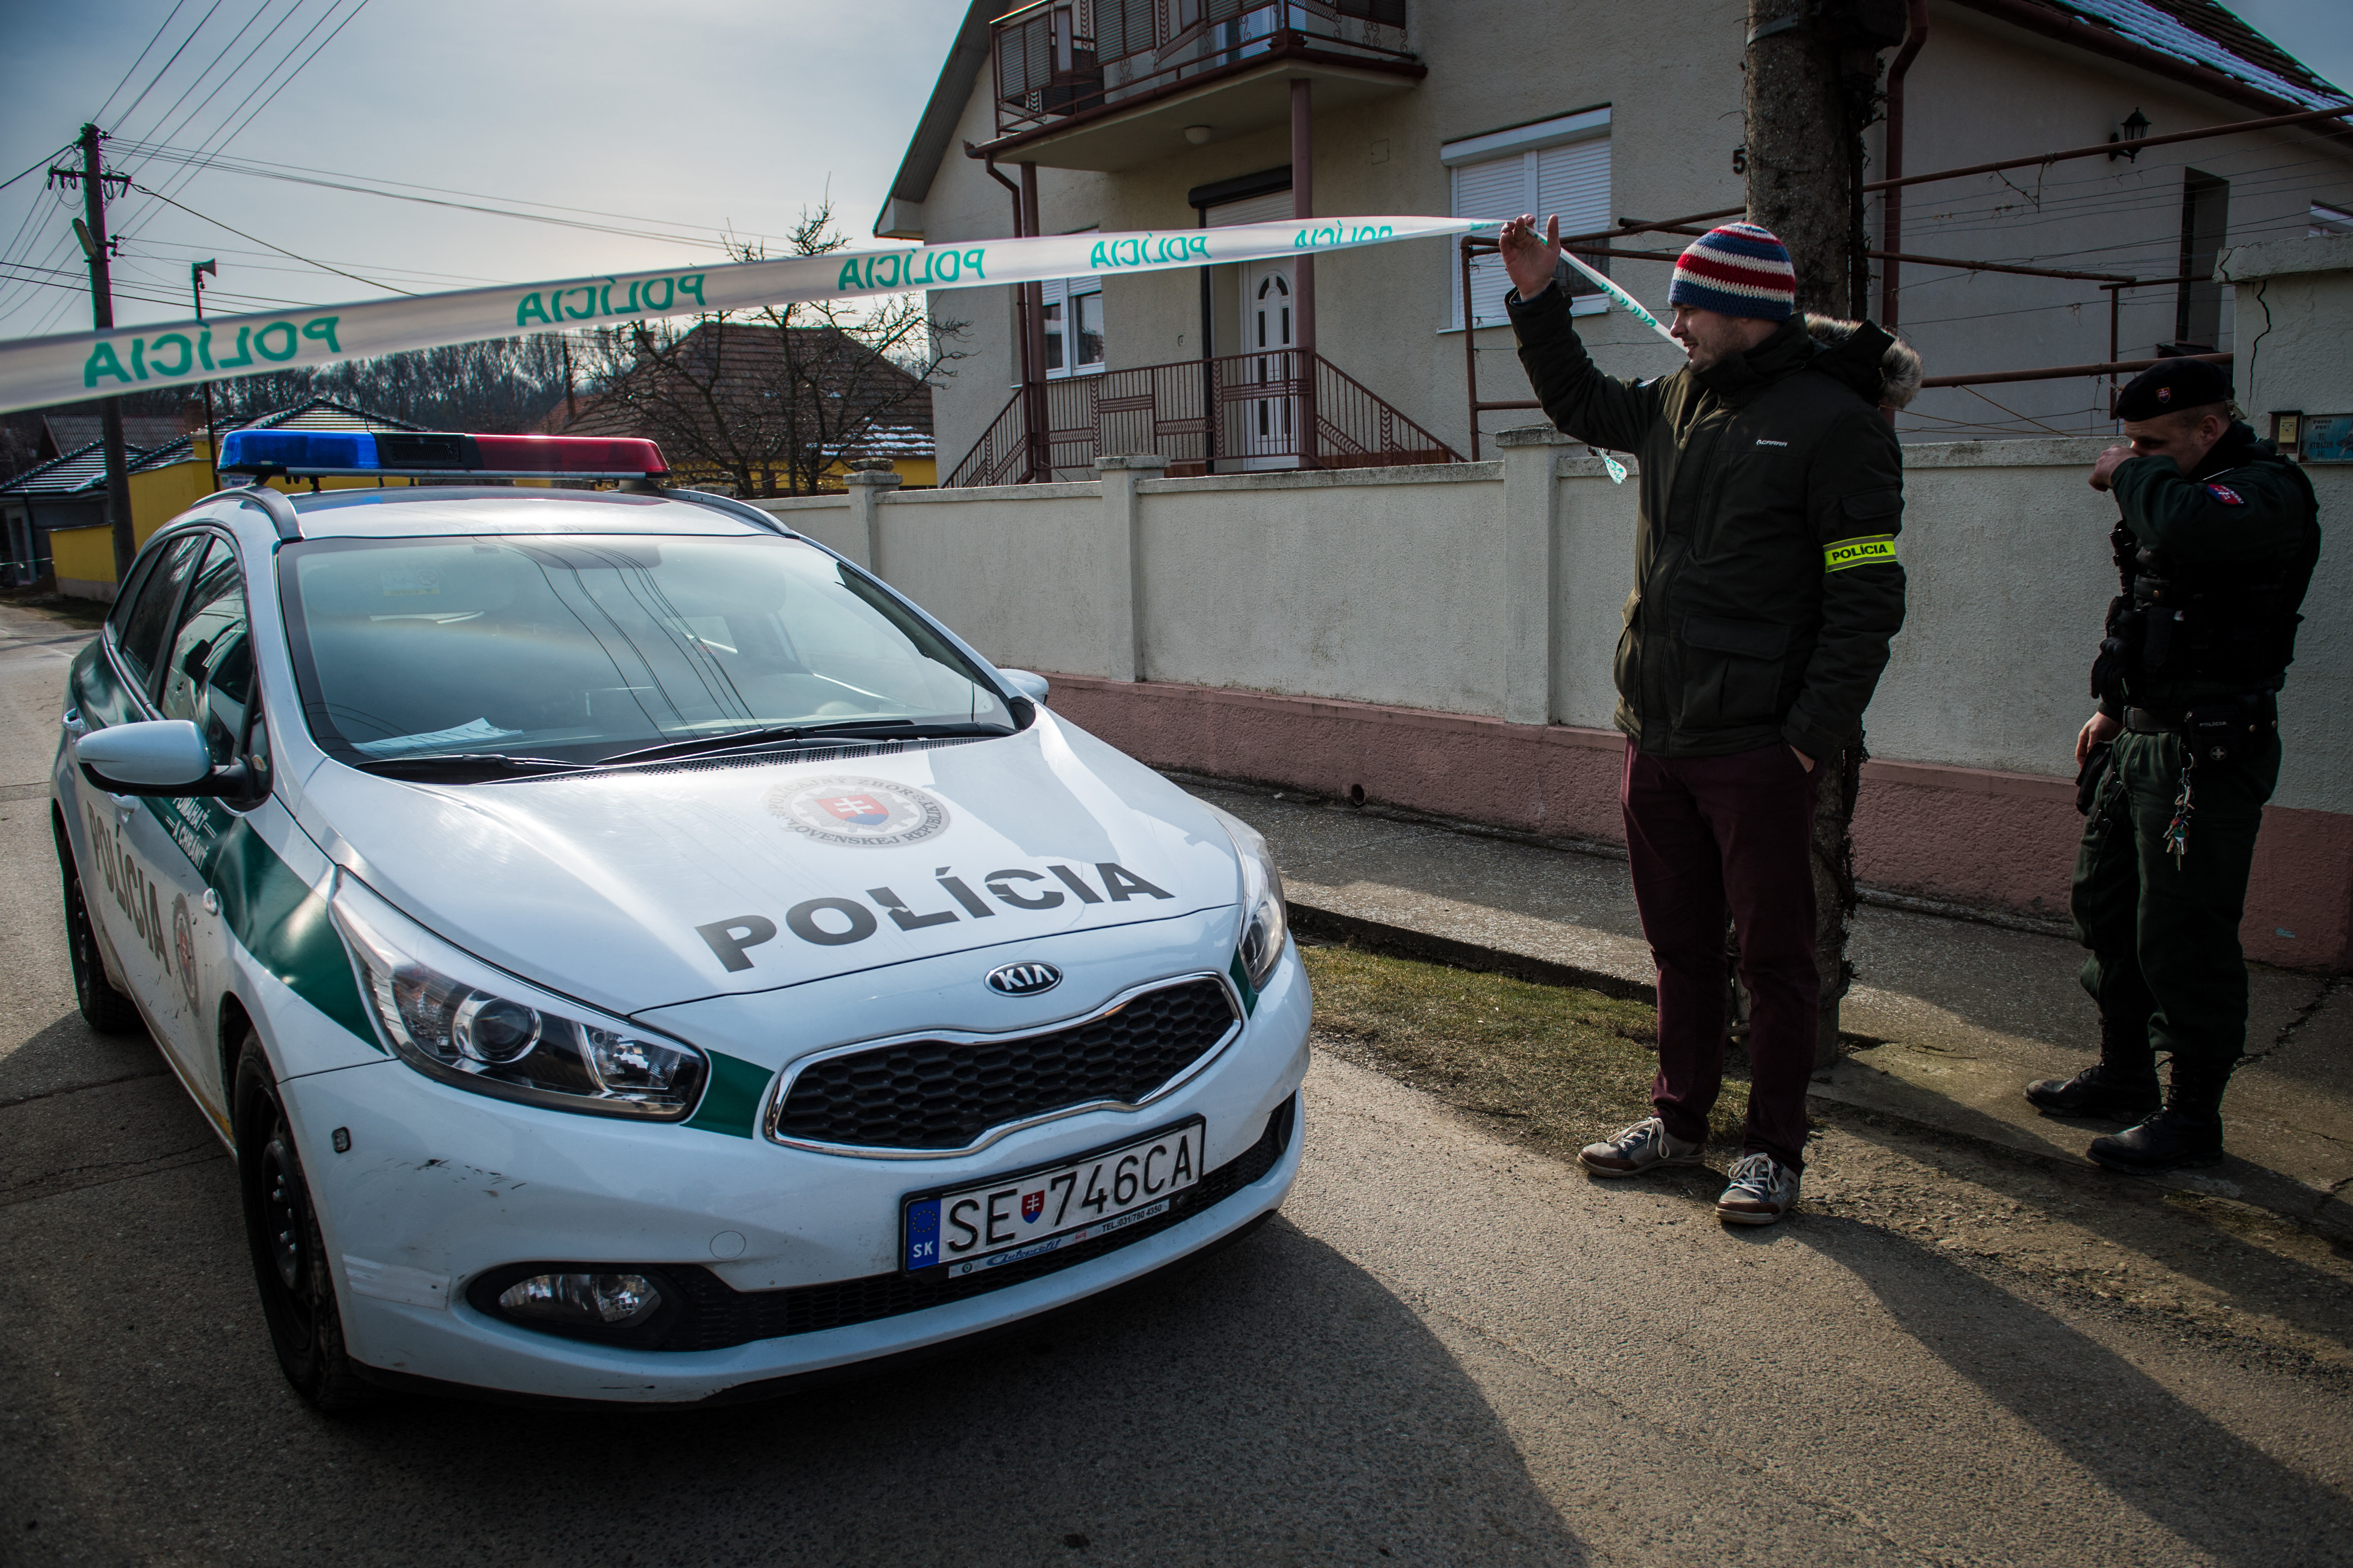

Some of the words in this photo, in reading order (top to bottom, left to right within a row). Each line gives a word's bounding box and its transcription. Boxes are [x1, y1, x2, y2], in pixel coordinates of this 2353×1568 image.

[1733, 148, 1746, 174] 5
[1832, 544, 1888, 561] POLÍCIA
[857, 779, 914, 796] ZBOR
[783, 817, 900, 845] LOVENSKEJ
[900, 800, 942, 841] REPUBLIKY
[172, 820, 181, 840] A
[179, 826, 209, 870] CHRÁNIŤ
[86, 799, 172, 977] POLÍCIA
[693, 862, 1176, 972] POLÍCIA
[995, 964, 1055, 990] KIA
[947, 1187, 1018, 1253] SE
[1050, 1134, 1192, 1226] 746CA
[1146, 1205, 1162, 1218] 4350
[913, 1240, 933, 1258] SK
